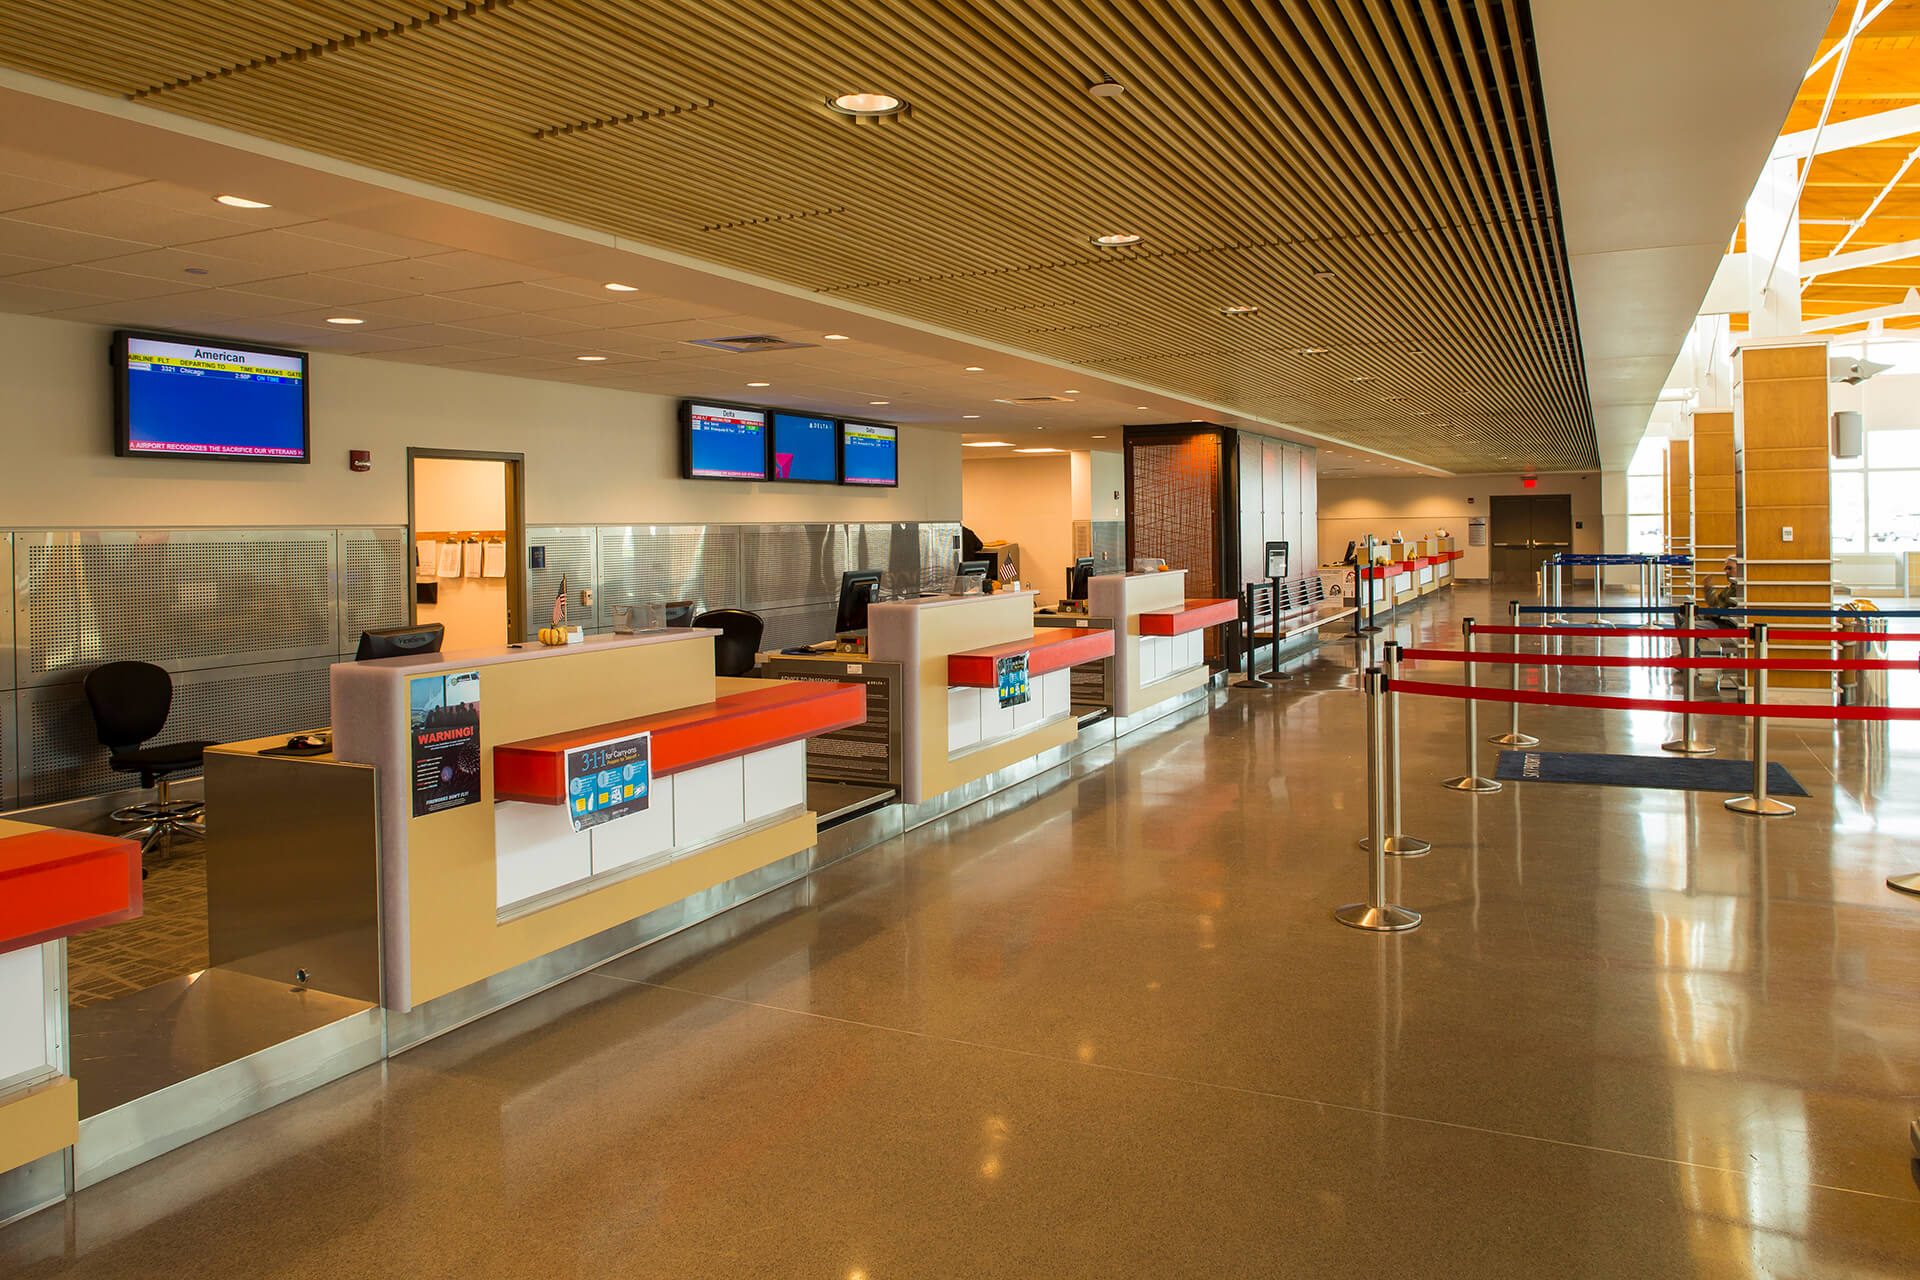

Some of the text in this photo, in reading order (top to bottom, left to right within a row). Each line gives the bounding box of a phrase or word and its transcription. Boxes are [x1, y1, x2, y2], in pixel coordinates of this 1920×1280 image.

[193, 348, 246, 364] American
[180, 359, 216, 369] DEPARTING
[255, 367, 283, 376] REMARKS
[180, 367, 205, 377] Chicago
[136, 442, 165, 450] AIRPORT
[222, 446, 253, 454] SACRIFICE
[267, 448, 297, 456] VETERANS
[418, 726, 474, 745] WARNING!
[582, 749, 607, 771] 3-1-1
